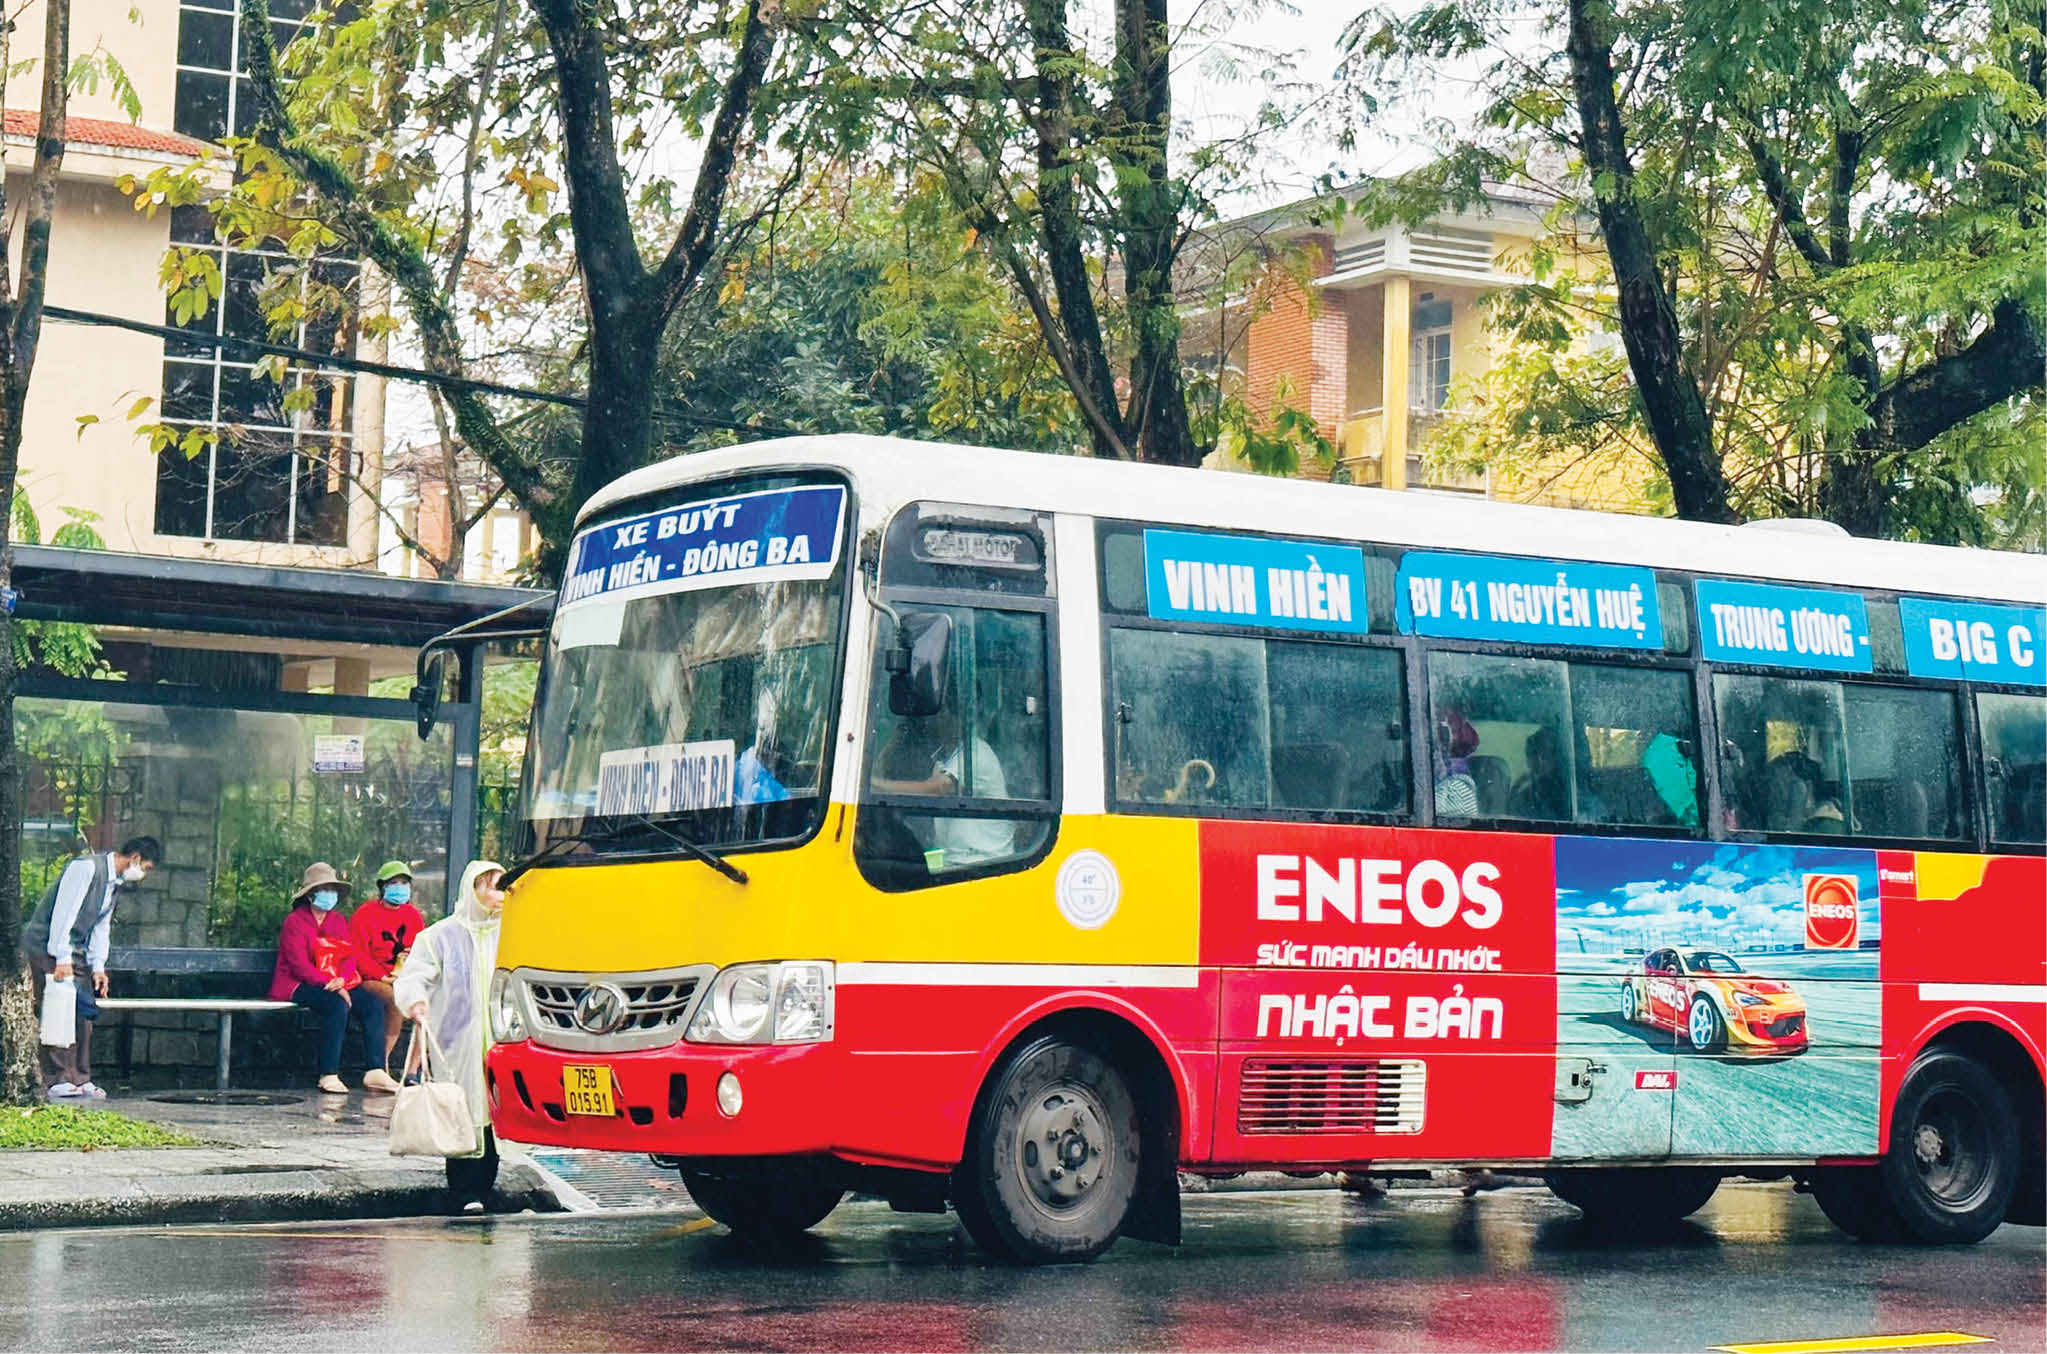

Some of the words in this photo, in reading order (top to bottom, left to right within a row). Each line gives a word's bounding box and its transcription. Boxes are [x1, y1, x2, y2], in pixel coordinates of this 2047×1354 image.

[612, 521, 650, 550] XE
[656, 503, 742, 540] BUÝT
[565, 567, 606, 603] VINH
[682, 540, 758, 576] ĐÔNG
[766, 535, 810, 565] BA
[1163, 559, 1257, 615] VINH
[1268, 554, 1352, 622] HIỀN
[1409, 577, 1441, 618] BV
[1451, 580, 1479, 620] 41
[1488, 572, 1591, 627] NGUYỄN
[1596, 583, 1646, 640] HUỆ
[1710, 603, 1788, 652] TRUNG
[1929, 618, 1998, 664] BIG
[2008, 625, 2034, 667] C
[709, 754, 728, 808] BA
[1256, 854, 1504, 929] ENEOS
[1808, 903, 1855, 919] ENEOS
[1256, 938, 1308, 966] SỨC
[1256, 985, 1395, 1046] NHẬT
[1404, 984, 1504, 1040] BẢN
[1649, 980, 1686, 1012] ENEOS
[575, 1068, 597, 1088] 75B
